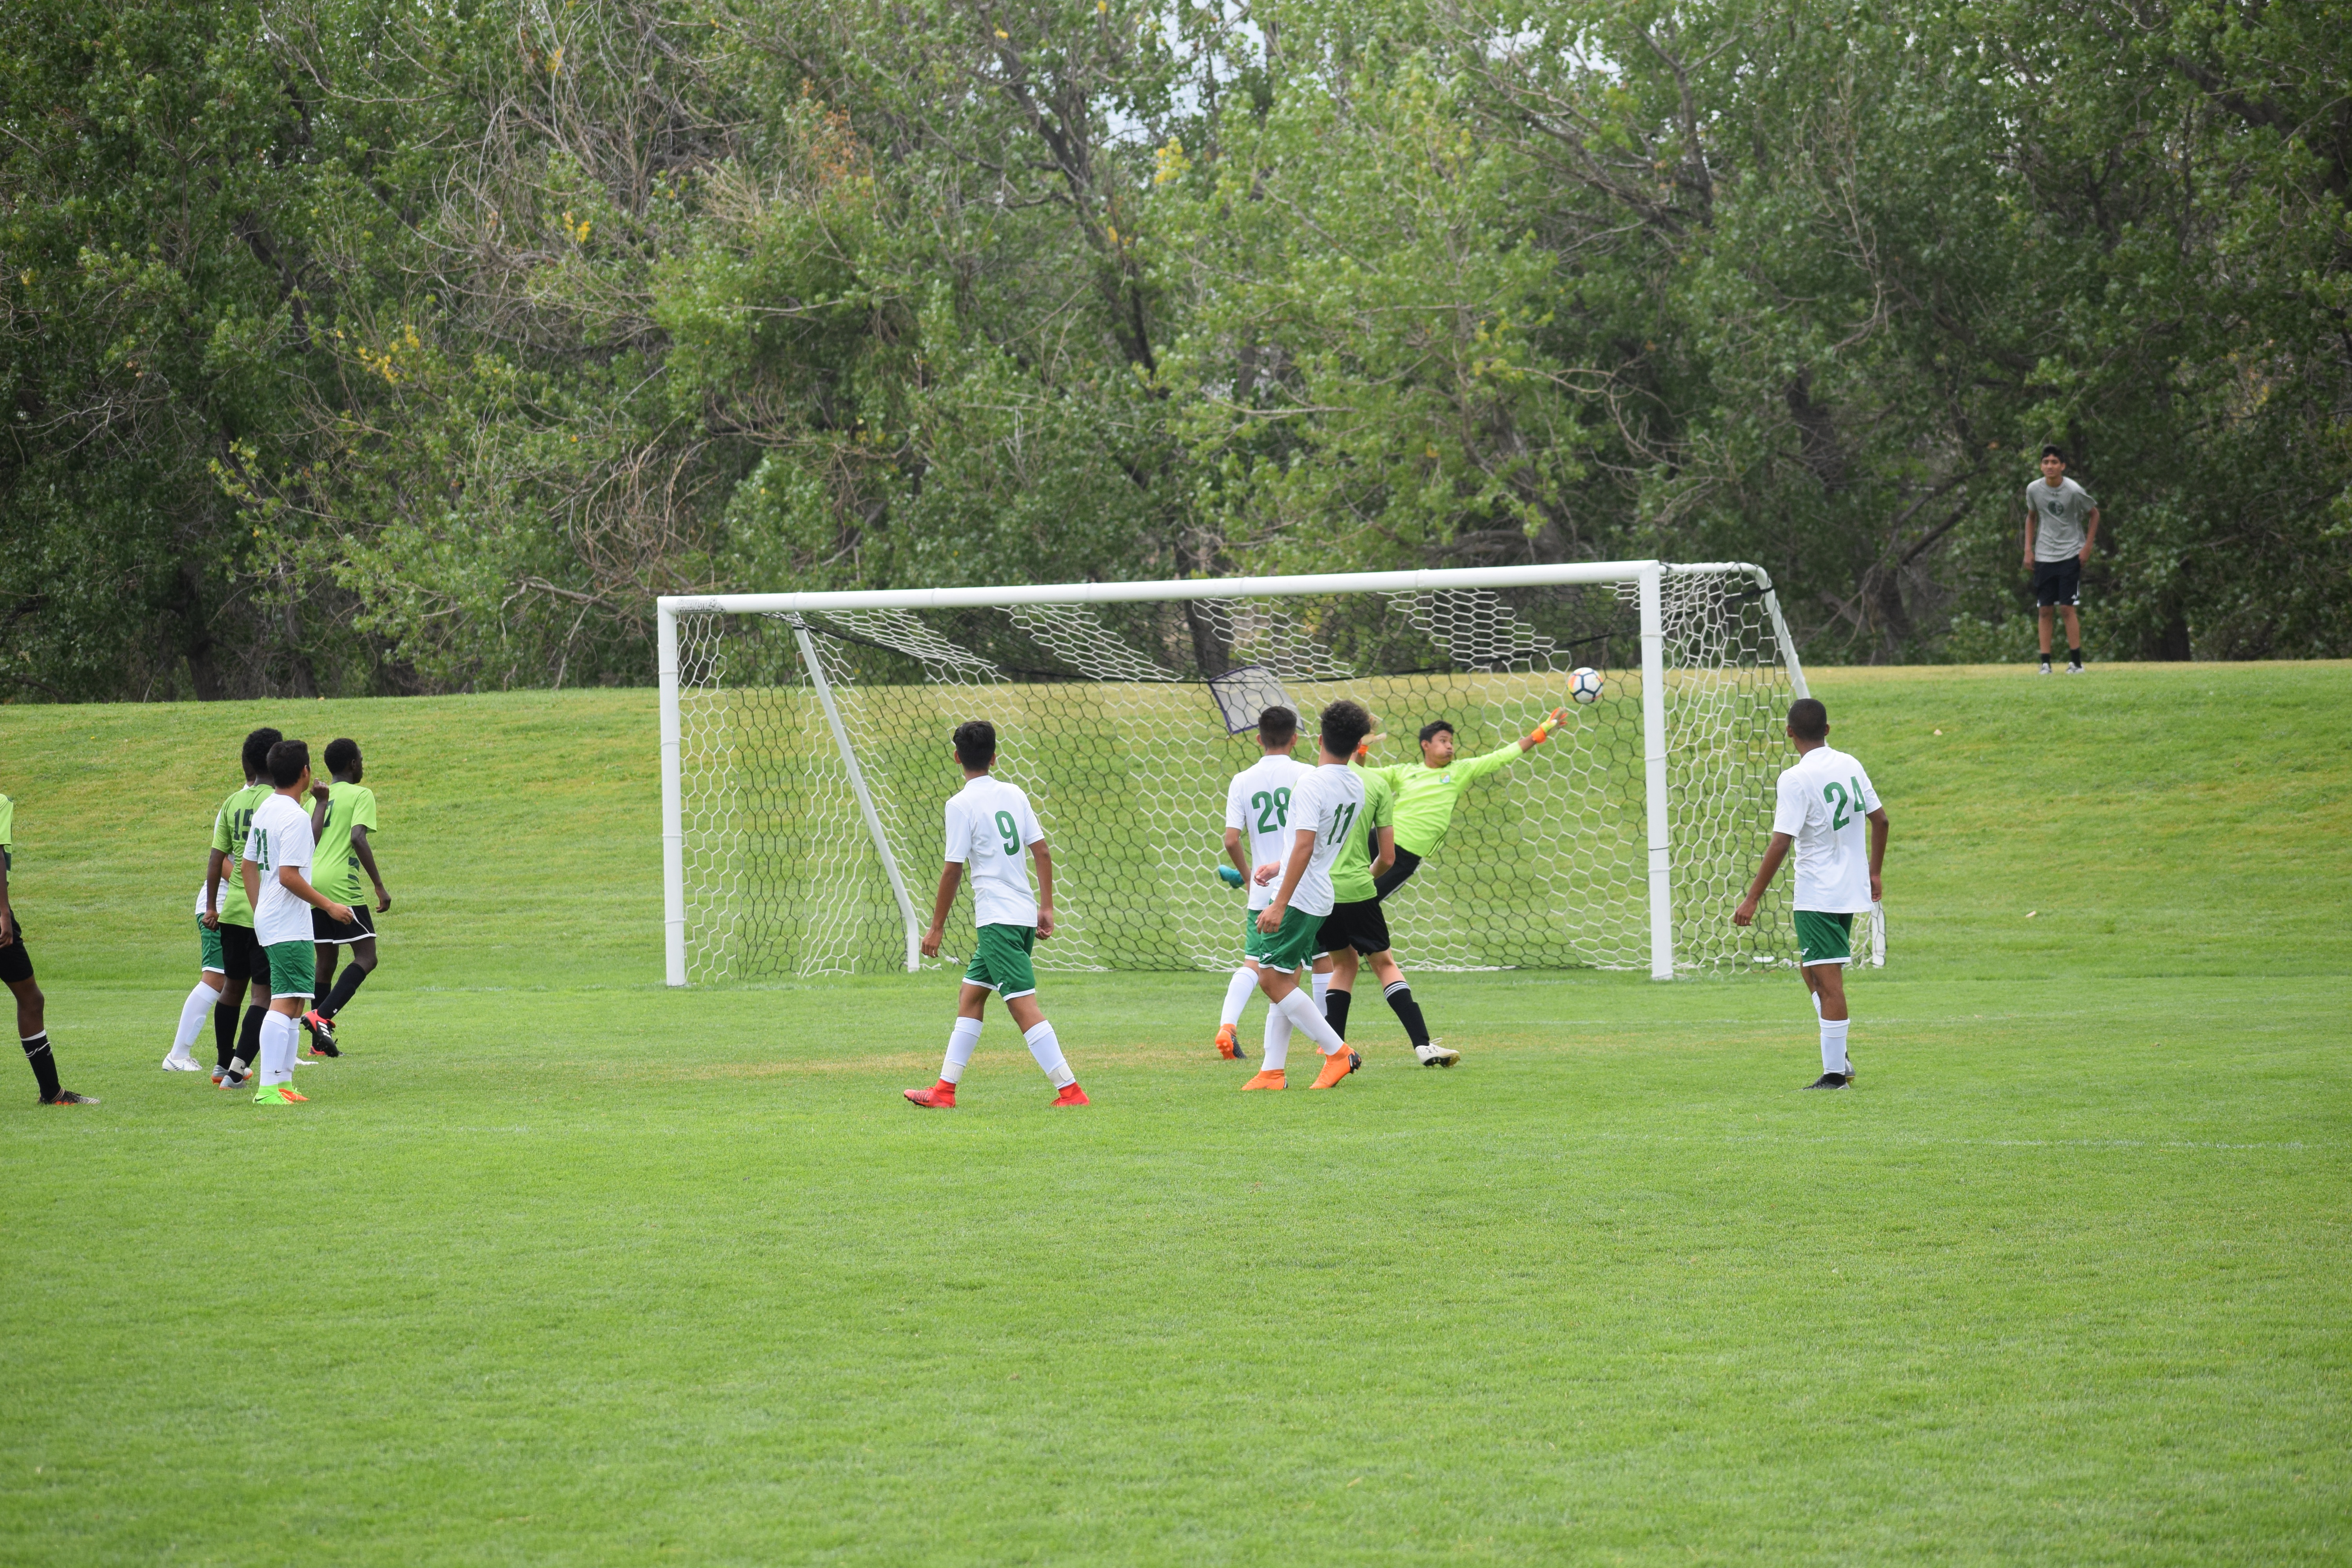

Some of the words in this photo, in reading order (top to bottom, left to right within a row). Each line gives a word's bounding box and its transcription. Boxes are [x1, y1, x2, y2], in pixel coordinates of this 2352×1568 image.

[234, 808, 254, 841] 15
[323, 799, 335, 828] 7
[1252, 787, 1291, 834] 28
[1327, 802, 1356, 846] 11
[1823, 776, 1866, 831] 24
[254, 827, 270, 871] 21
[995, 810, 1020, 856] 9
